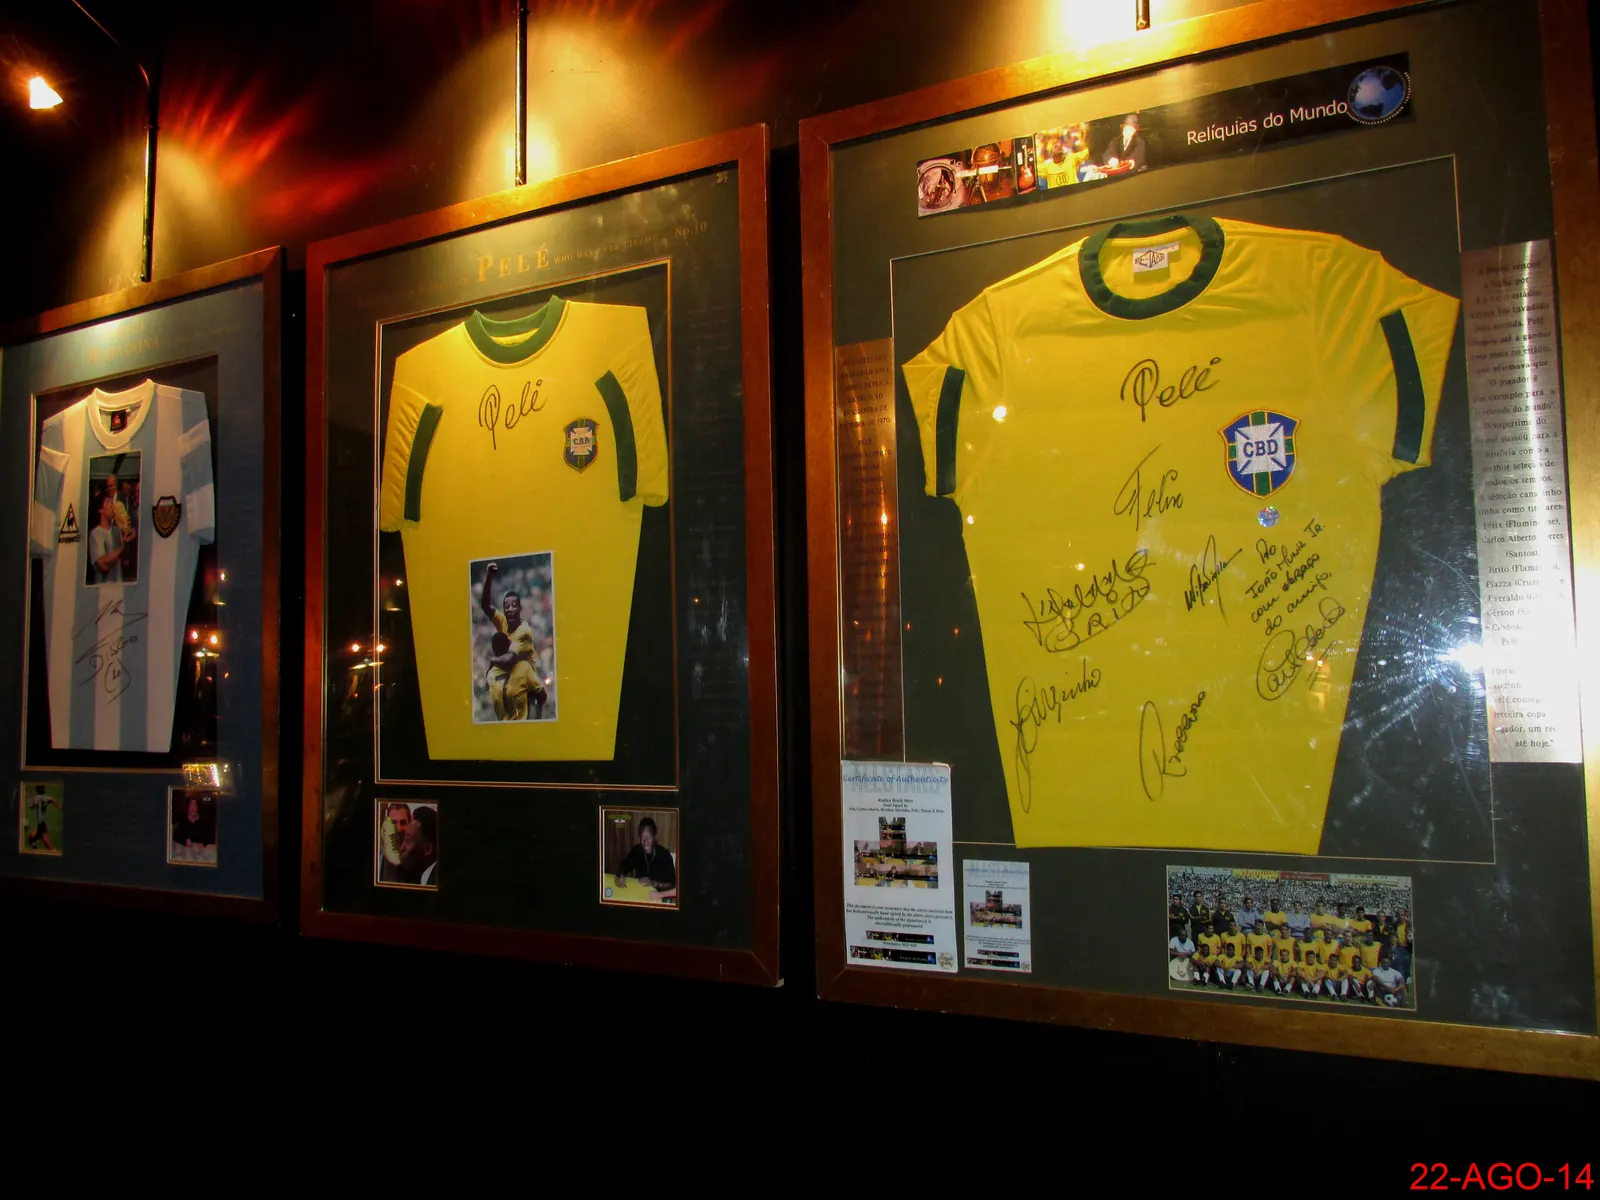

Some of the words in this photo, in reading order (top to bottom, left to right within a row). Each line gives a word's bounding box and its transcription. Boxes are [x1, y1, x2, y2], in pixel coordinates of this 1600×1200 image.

[1187, 118, 1257, 147] Relíquias
[1264, 110, 1284, 130] do
[1290, 99, 1348, 124] Mundo
[476, 242, 550, 283] PELÉ
[1242, 438, 1279, 459] CBD
[1502, 506, 1525, 515] como
[1508, 533, 1537, 543] Alberto
[1528, 724, 1542, 733] um
[1515, 739, 1528, 749] até
[886, 774, 896, 784] of
[896, 773, 949, 786] Authenticity
